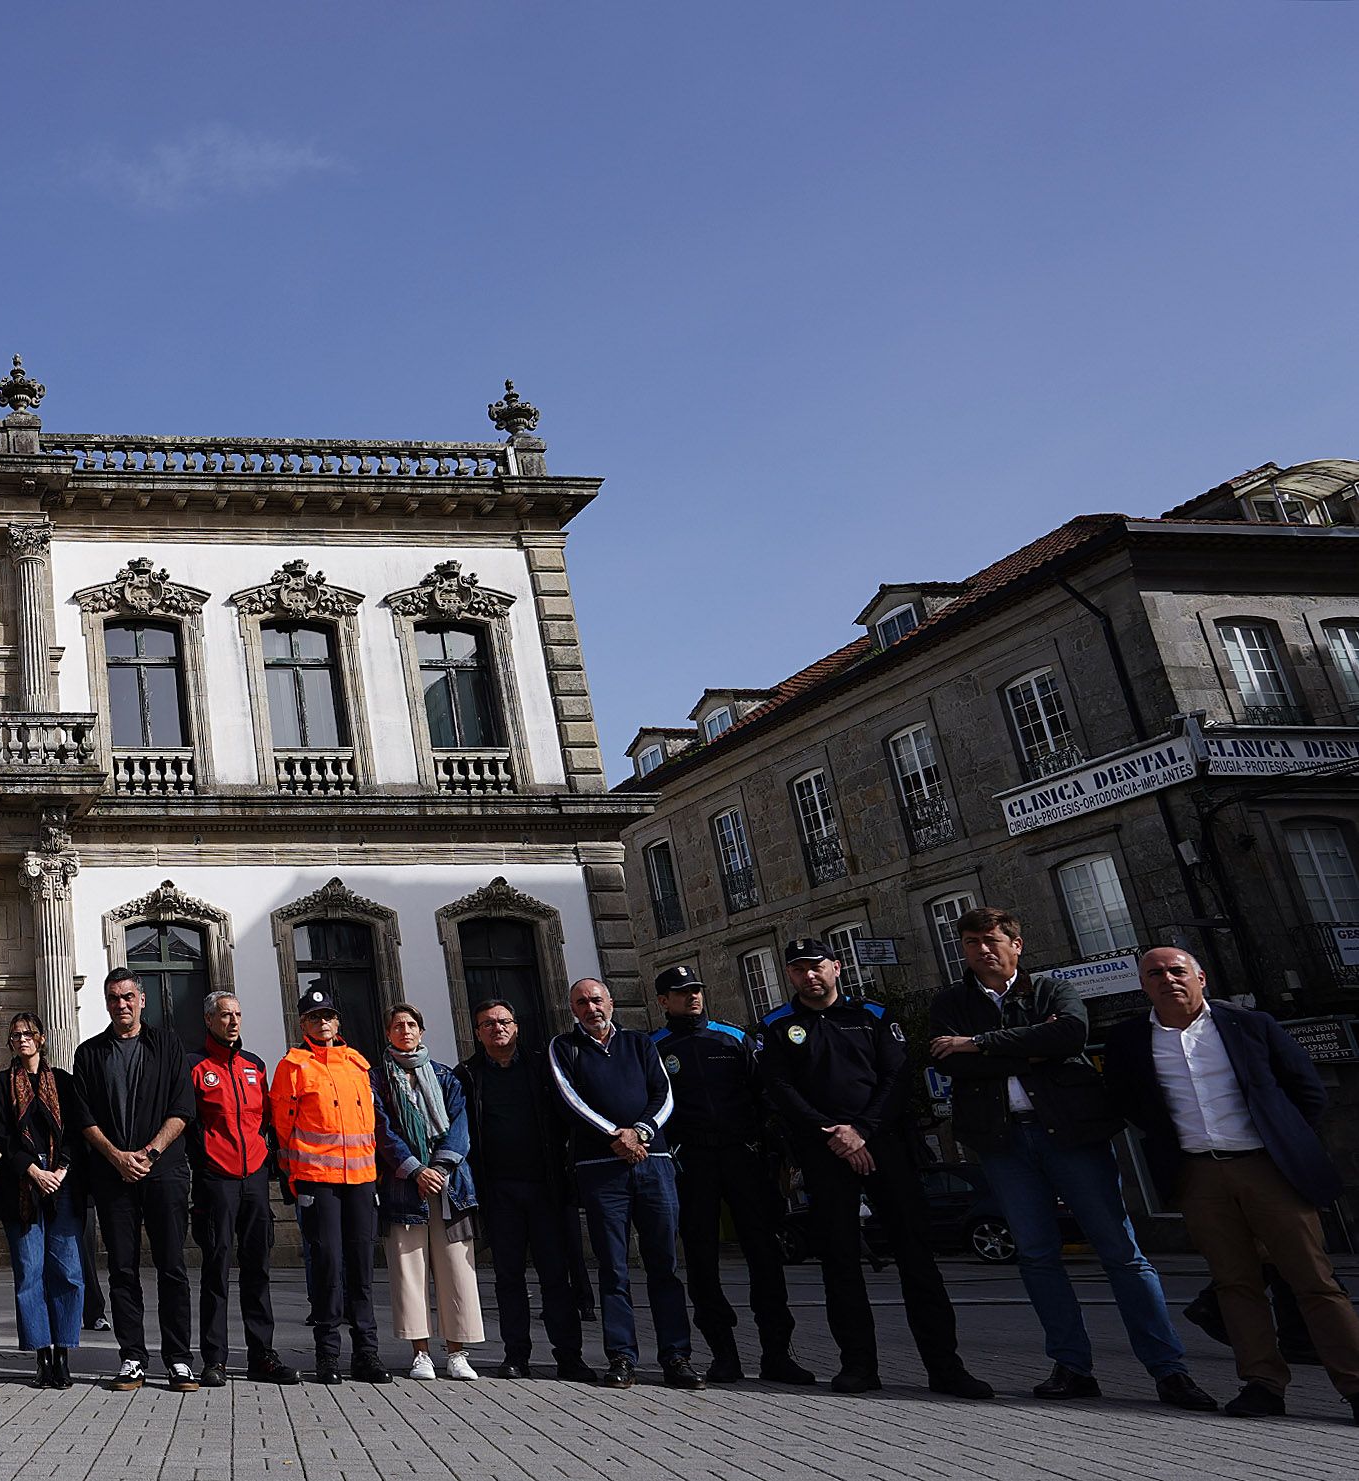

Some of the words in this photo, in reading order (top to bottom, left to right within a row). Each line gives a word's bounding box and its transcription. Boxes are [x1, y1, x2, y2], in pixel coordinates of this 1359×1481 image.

[1007, 780, 1086, 818] CLINICA
[1092, 746, 1185, 790] DENTAL
[1204, 740, 1296, 757] CLINICA
[1008, 763, 1194, 834] CIRUGIA-PROTESIS-ORTODONCIA-IMPLANTES
